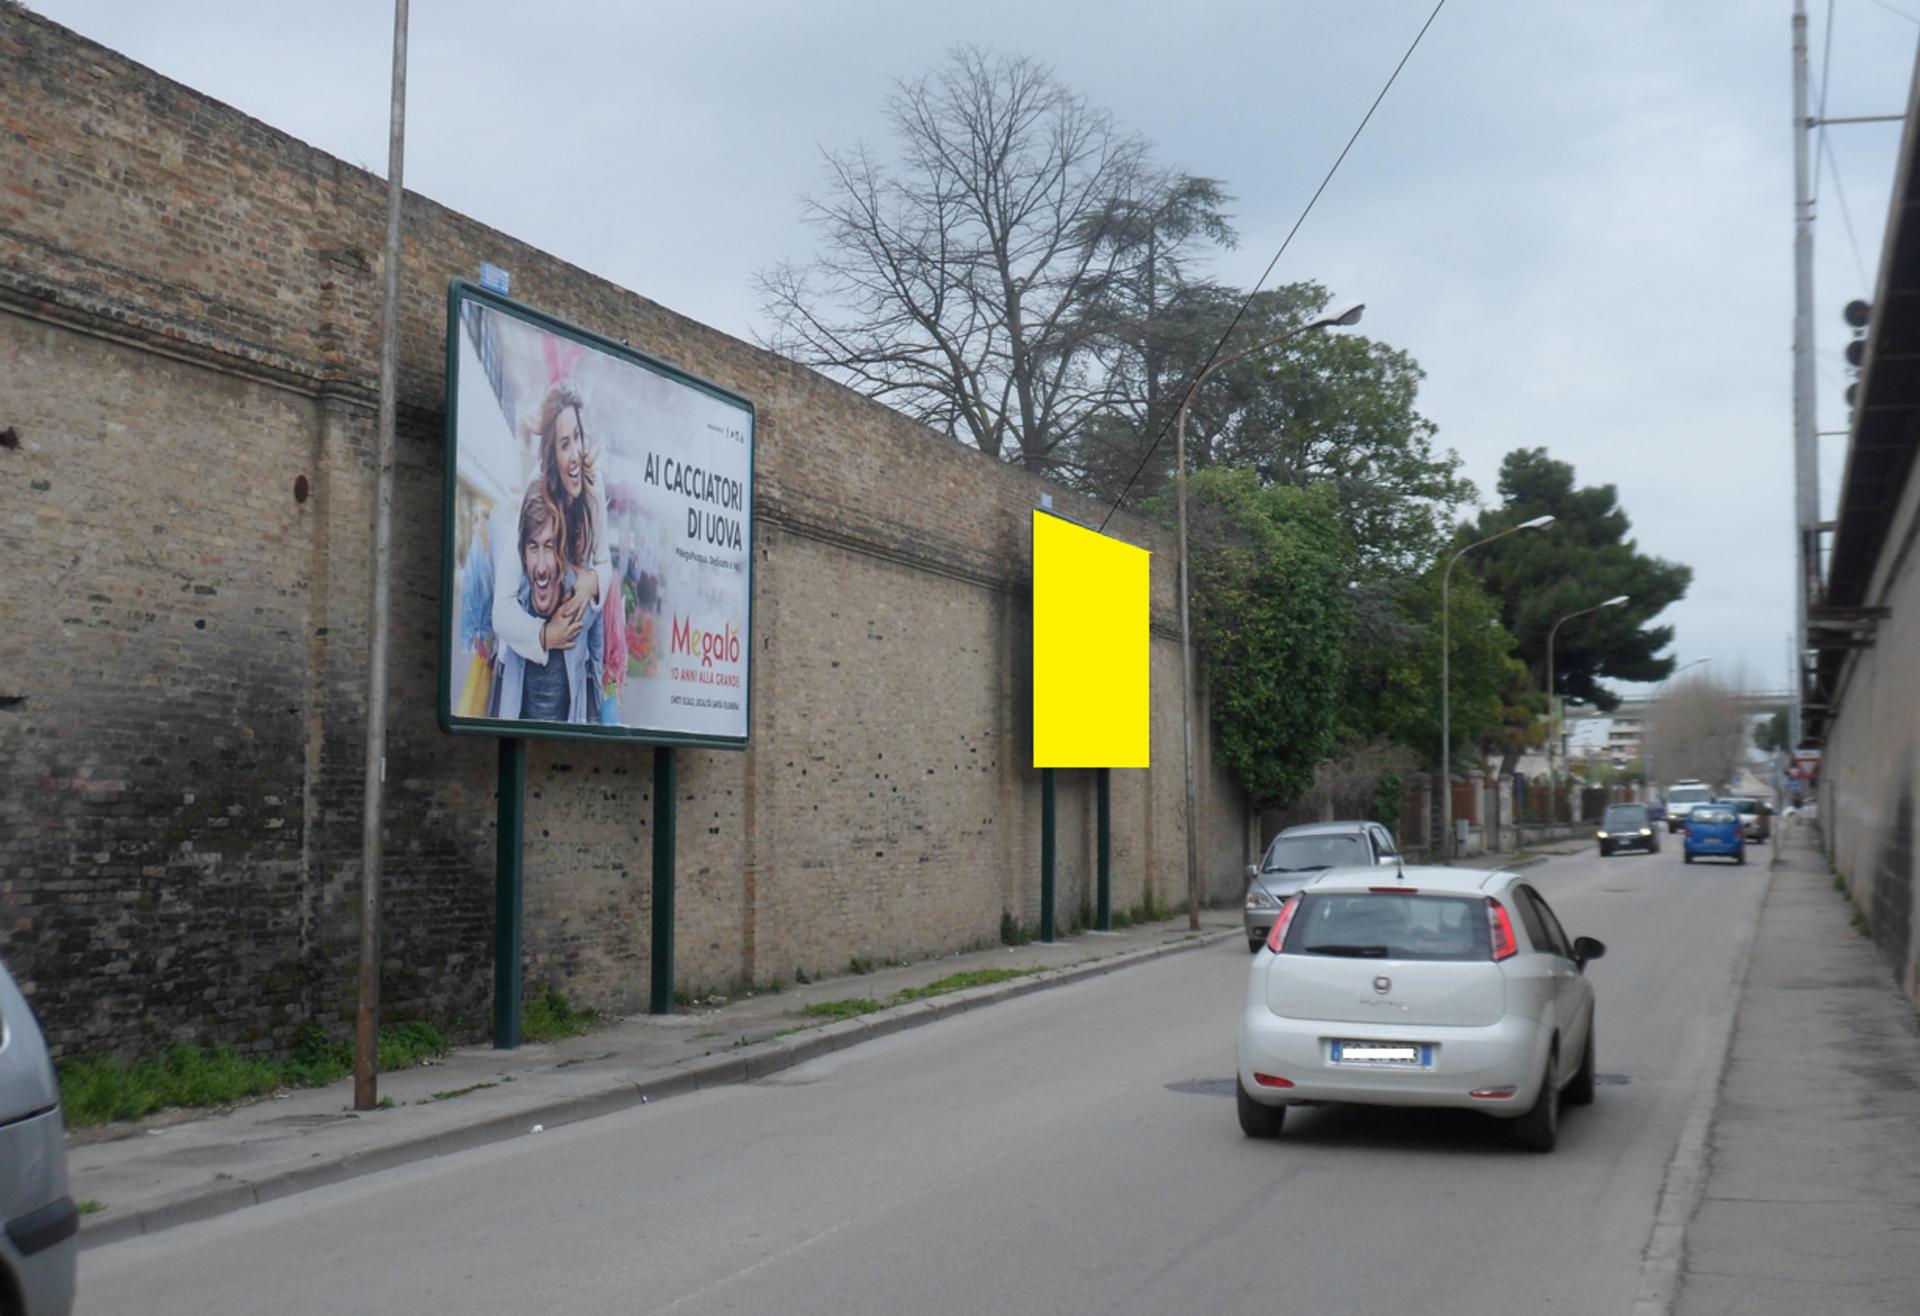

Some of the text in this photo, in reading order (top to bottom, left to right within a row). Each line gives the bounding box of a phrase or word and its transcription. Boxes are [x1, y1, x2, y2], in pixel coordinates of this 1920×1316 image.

[644, 451, 743, 512] AI CACCIATORI
[687, 507, 742, 551] DI UOVA
[680, 668, 698, 682] ANNI
[699, 671, 715, 685] ALLA
[716, 672, 741, 689] GRANDE
